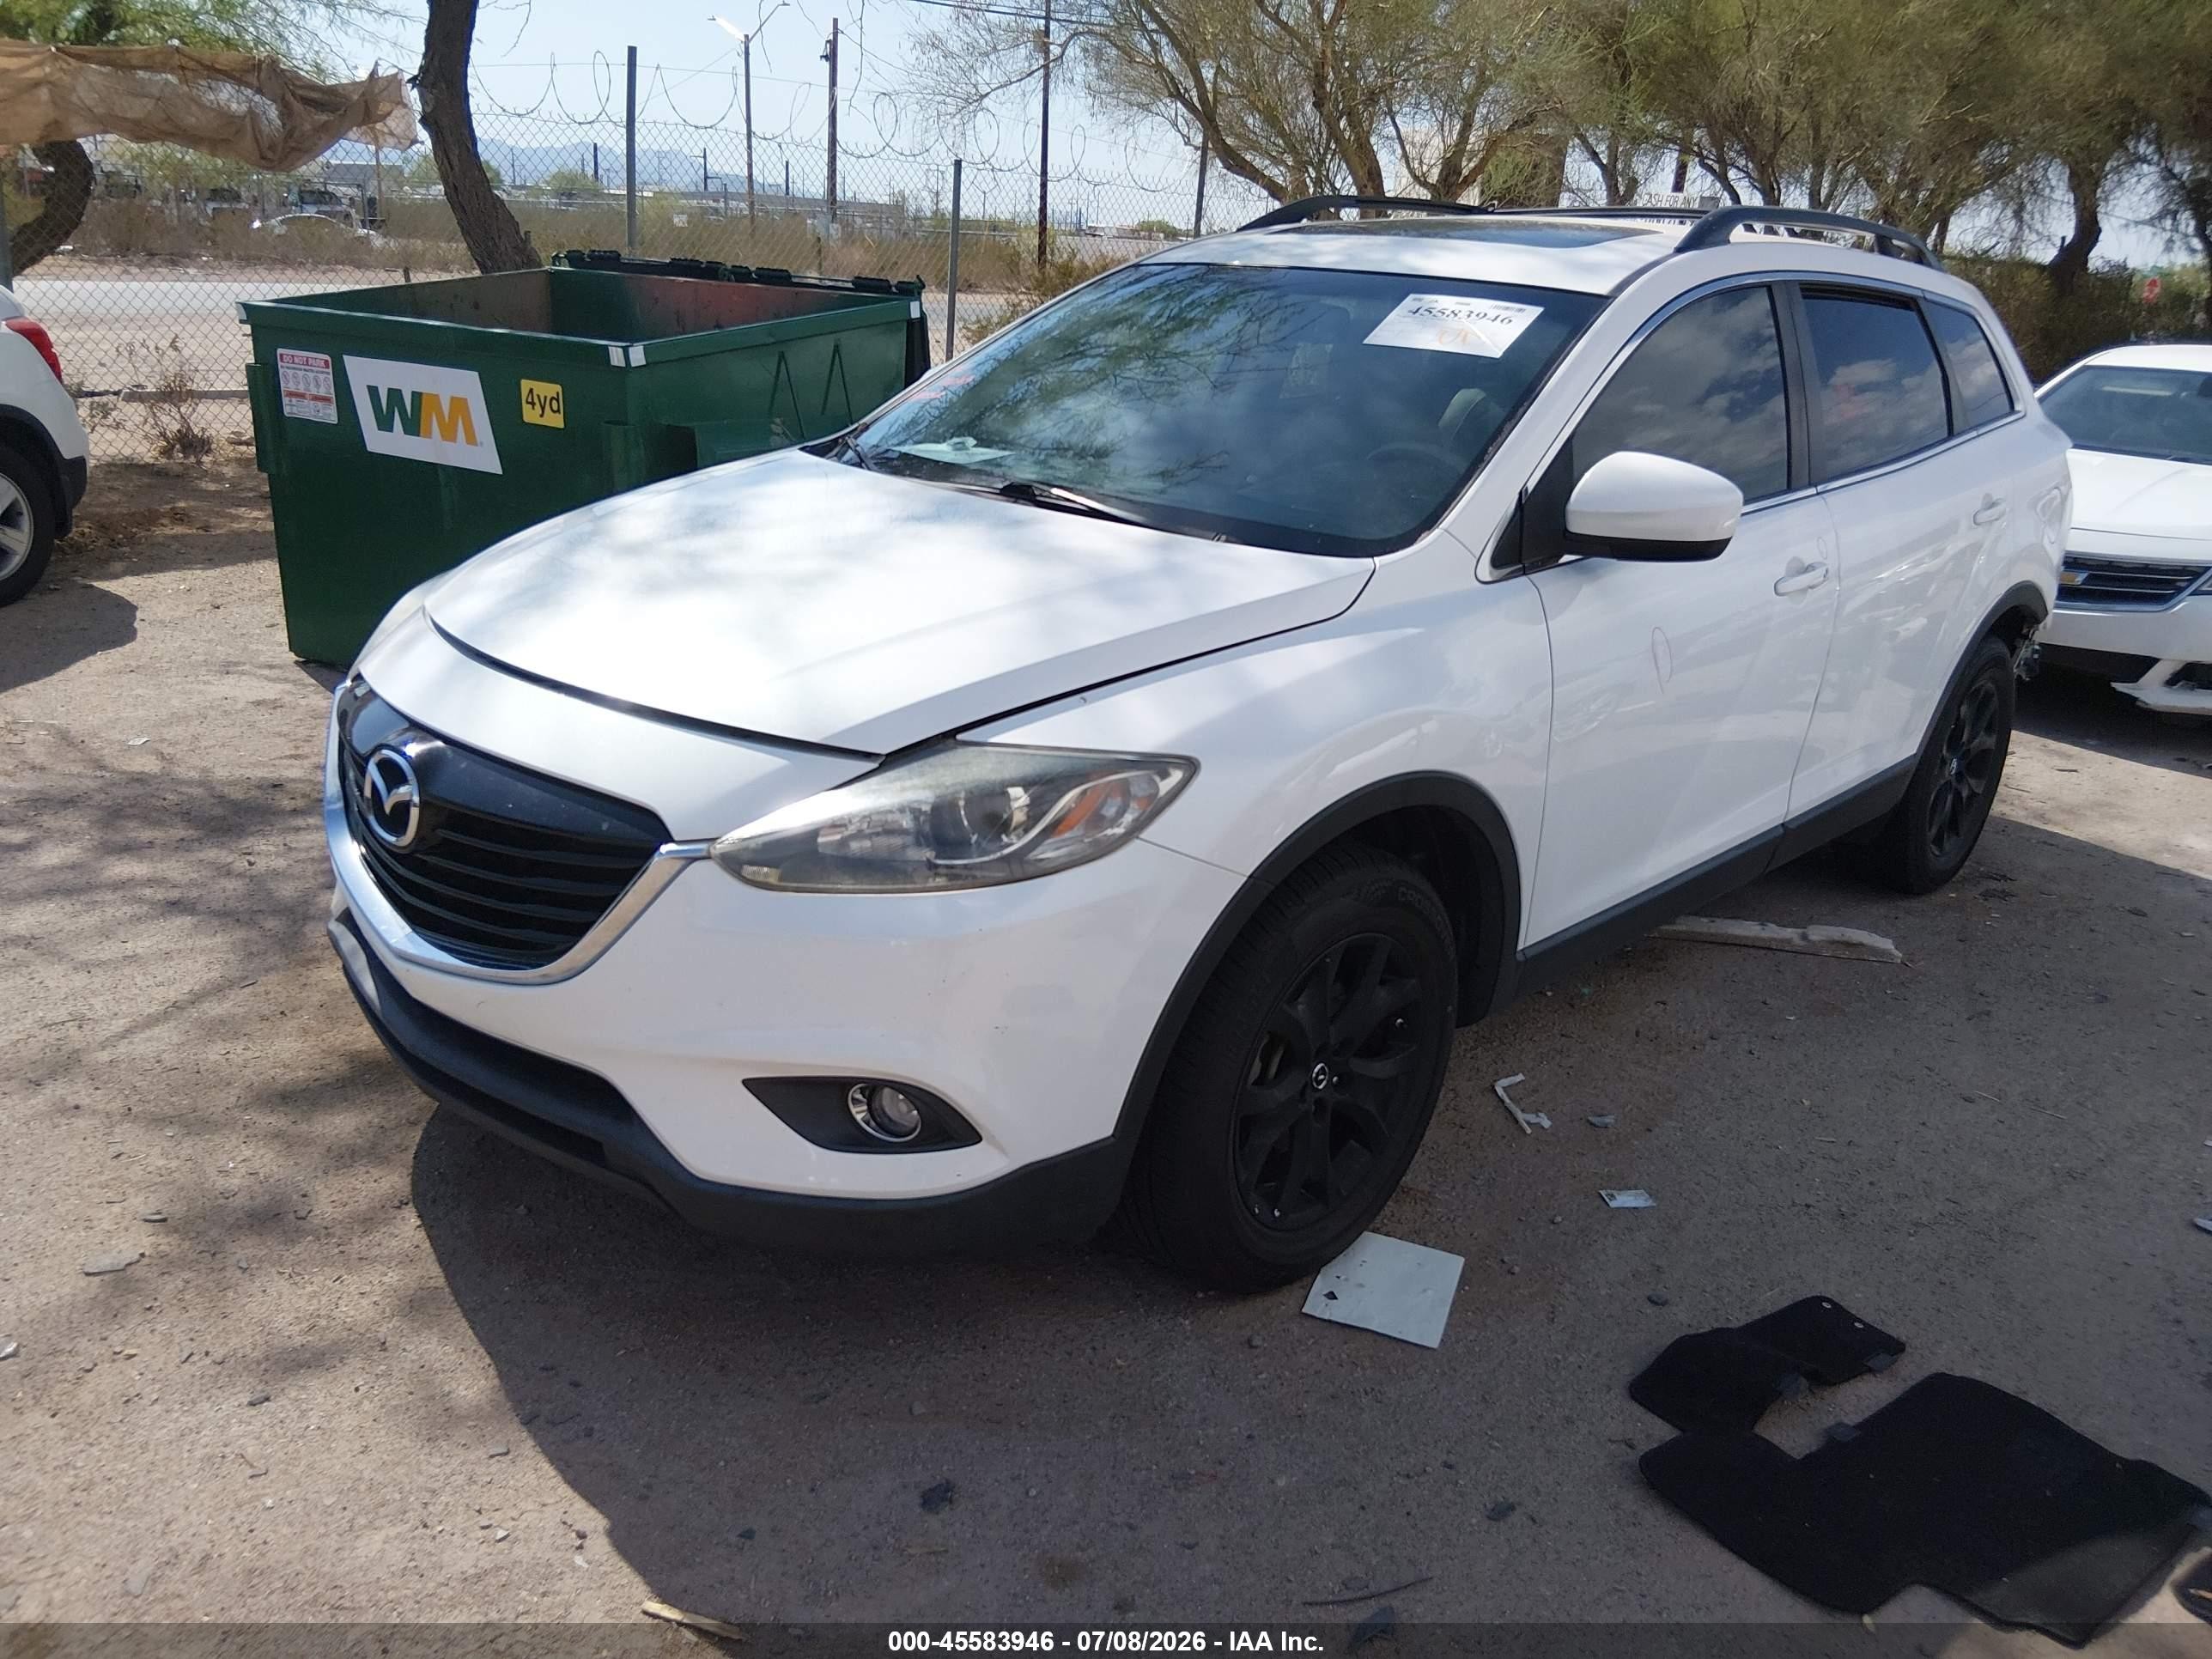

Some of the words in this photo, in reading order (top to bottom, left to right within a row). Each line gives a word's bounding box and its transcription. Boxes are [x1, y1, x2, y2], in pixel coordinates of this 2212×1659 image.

[1643, 193, 1664, 207] CASH
[1666, 195, 1680, 207] FOR
[1680, 196, 1698, 208] ANY
[1407, 306, 1513, 325] 45583946
[283, 355, 294, 364] DO
[294, 356, 307, 366] NOT
[525, 387, 562, 418] 4yd
[366, 385, 478, 447] WM
